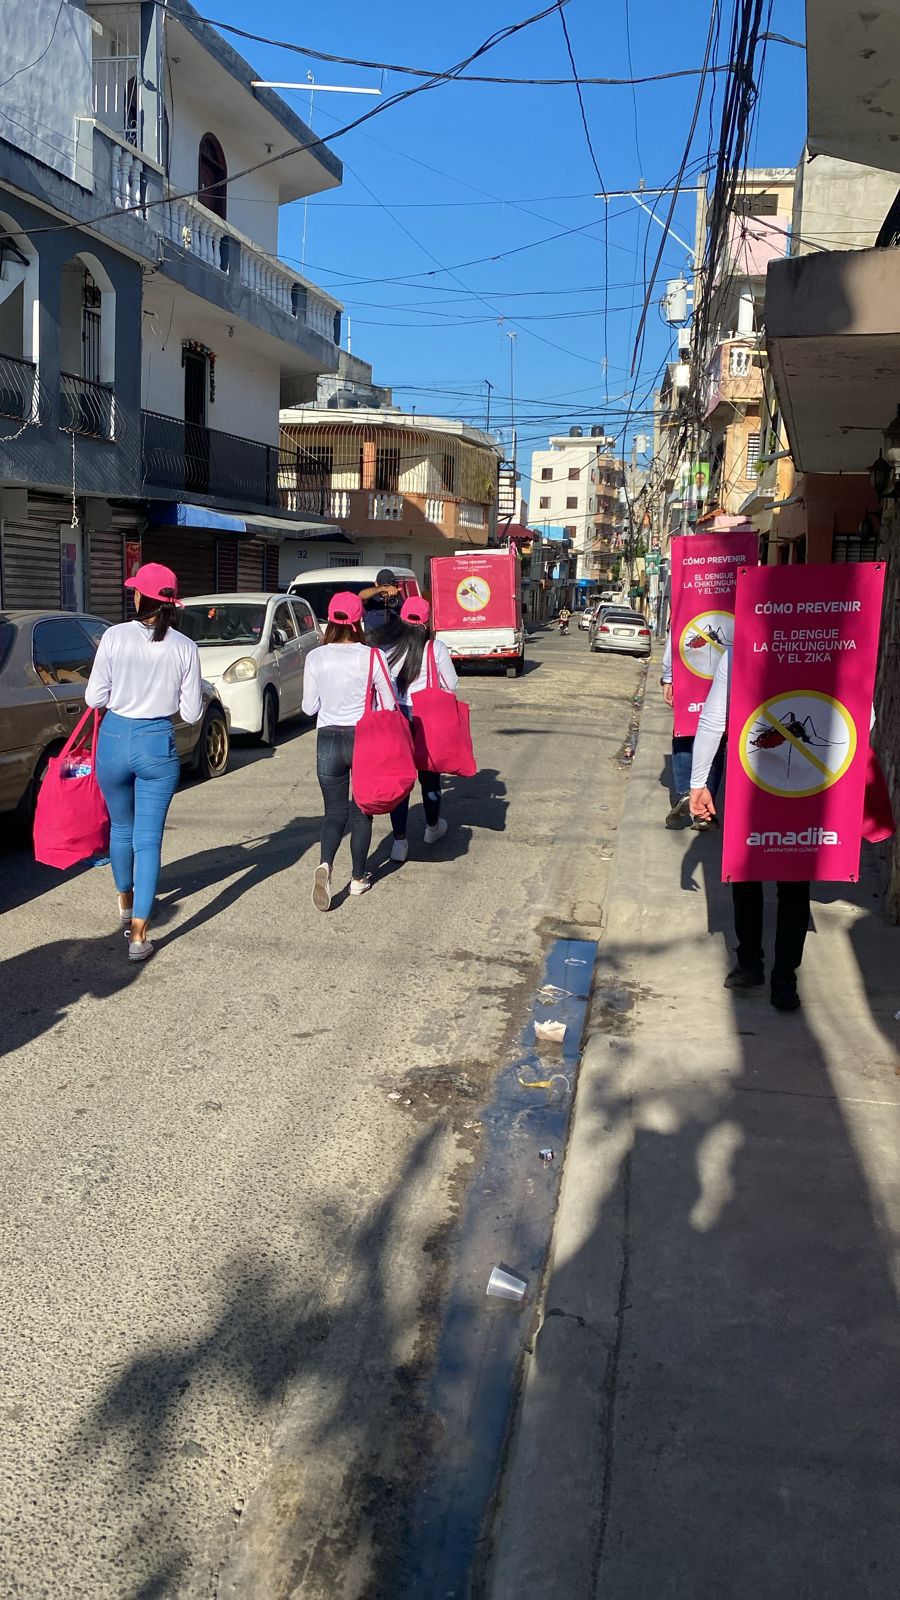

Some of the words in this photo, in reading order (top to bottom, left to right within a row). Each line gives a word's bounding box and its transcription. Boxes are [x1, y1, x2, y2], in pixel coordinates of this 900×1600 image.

[297, 550, 309, 559] 32
[682, 556, 706, 565] CÓMO
[707, 554, 746, 564] PREVENIR
[704, 572, 735, 580] DENGUE
[683, 581, 693, 589] LA
[694, 579, 737, 588] CHIKUNGUN
[754, 601, 793, 614] CÓMO
[796, 600, 862, 613] PREVENIR
[773, 630, 788, 640] EL
[790, 629, 839, 640] DENGUE
[753, 642, 769, 652] LA
[771, 640, 857, 652] CHIKUNGUNYA
[777, 653, 785, 663] Y
[788, 653, 801, 663] EL
[805, 652, 832, 663] ZIKA
